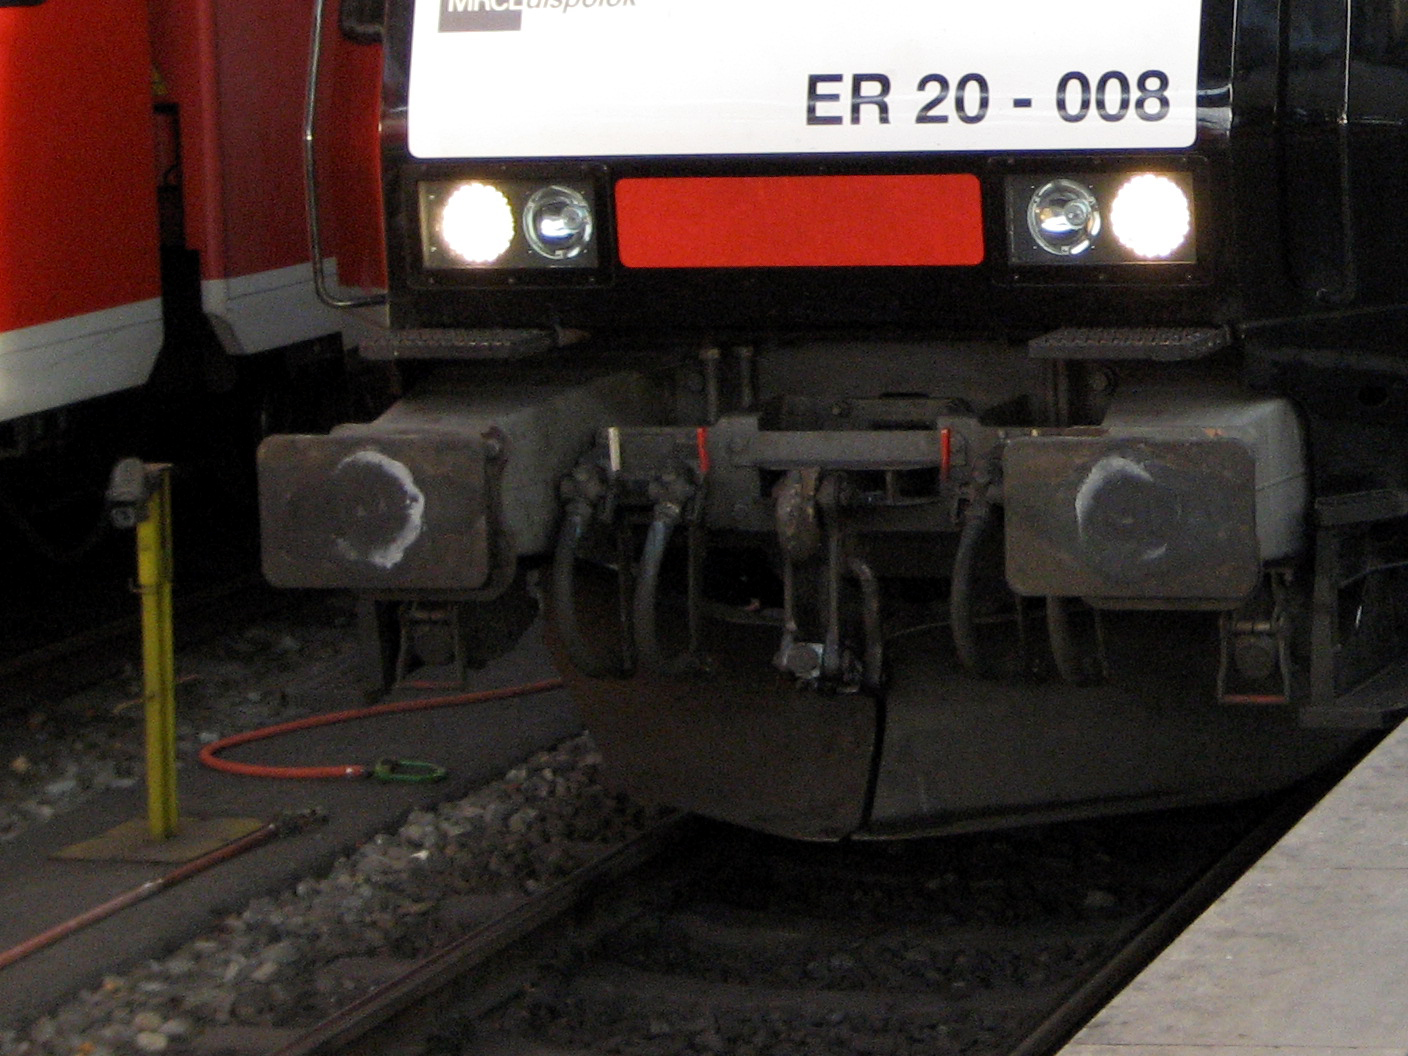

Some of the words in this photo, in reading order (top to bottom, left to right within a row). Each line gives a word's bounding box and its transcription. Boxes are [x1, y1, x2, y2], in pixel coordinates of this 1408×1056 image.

[806, 73, 892, 126] ER
[914, 72, 990, 125] 20
[1055, 69, 1171, 124] 008
